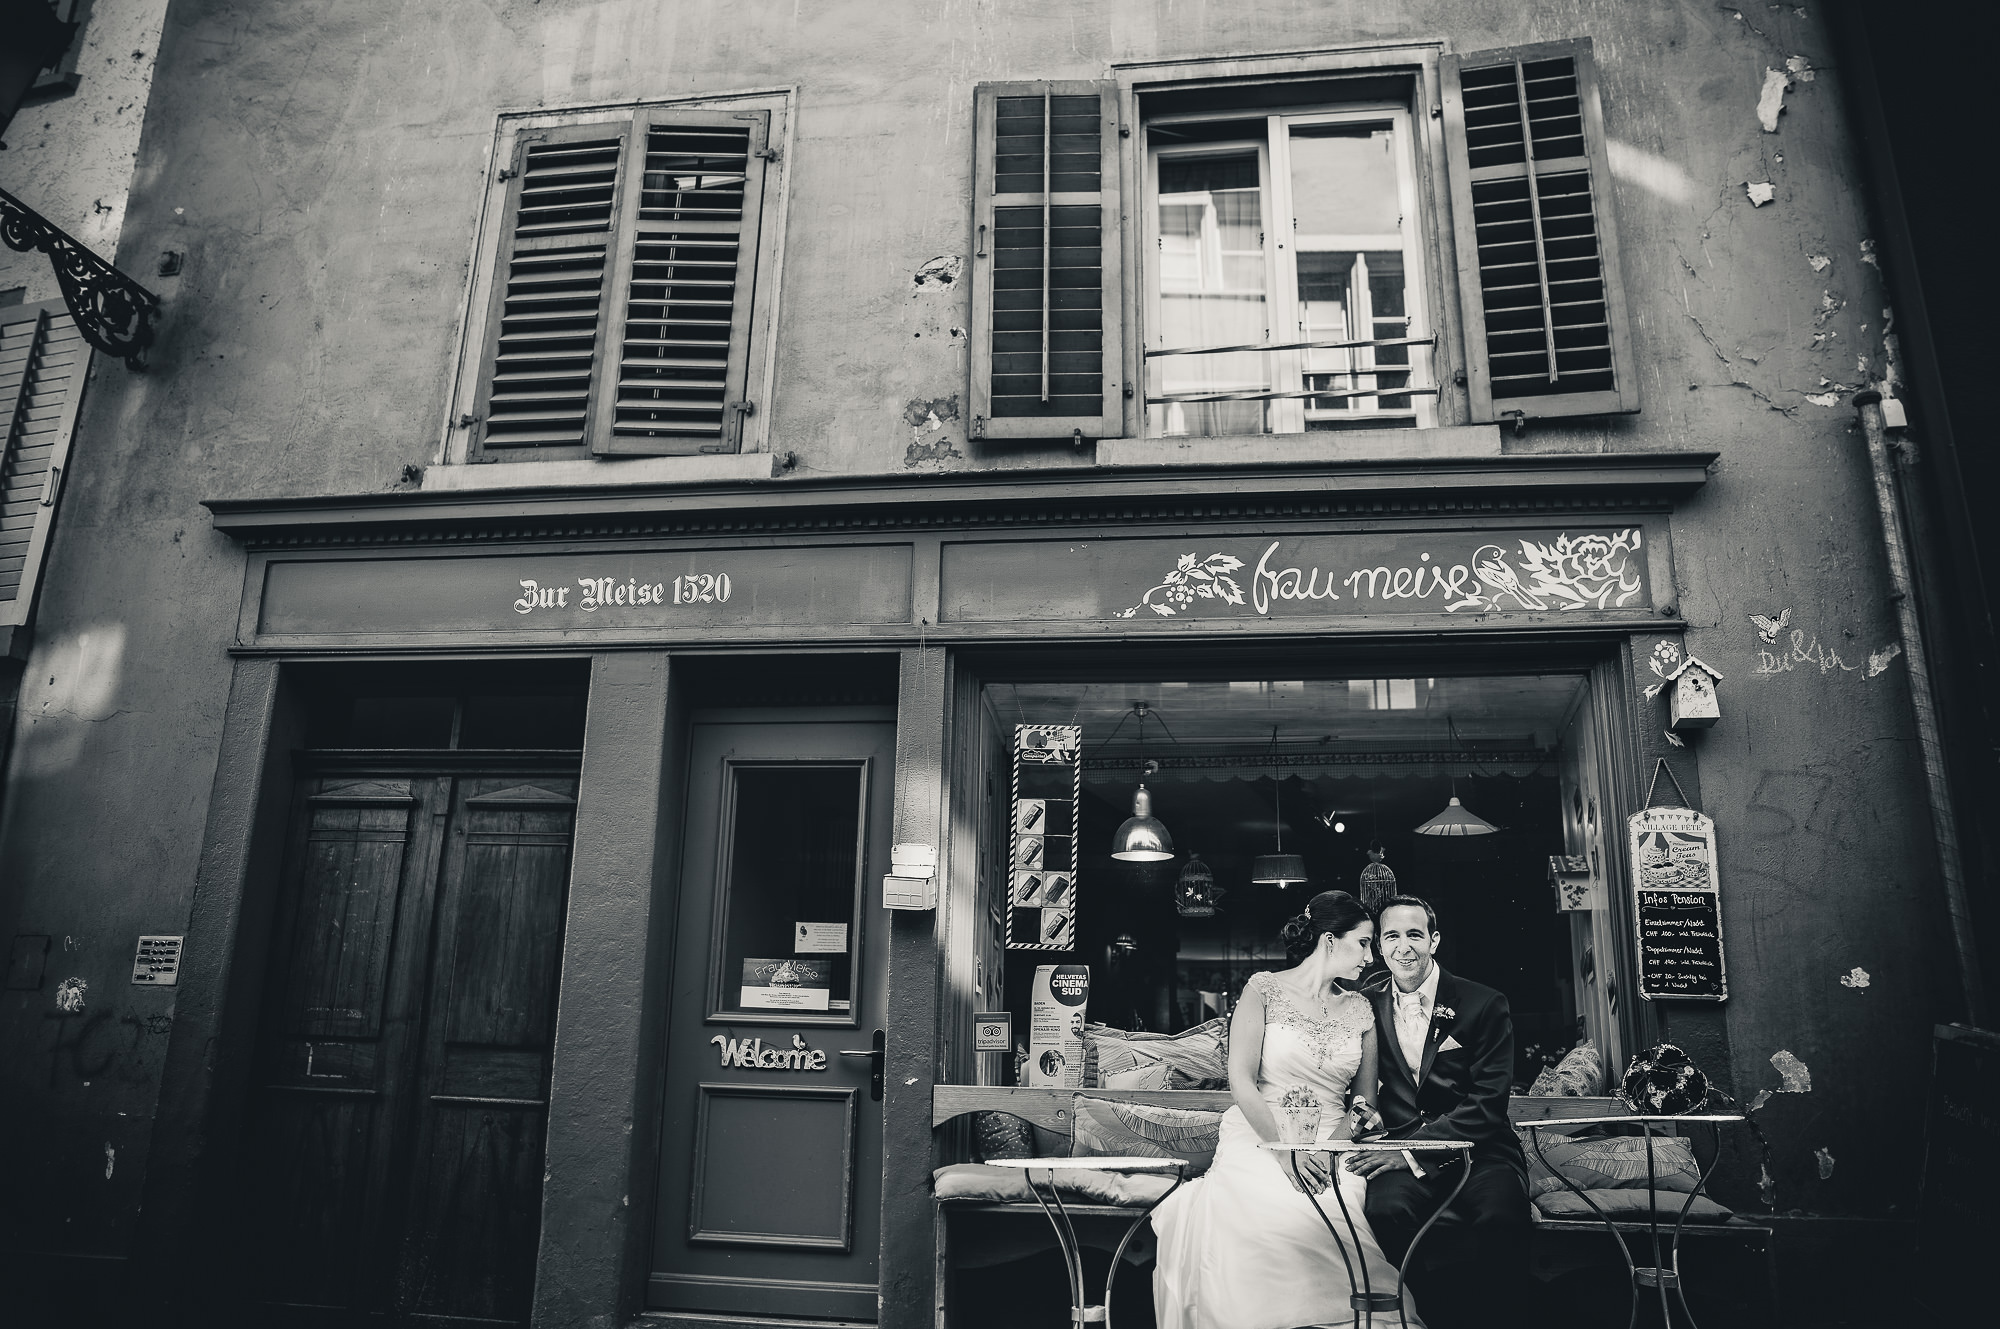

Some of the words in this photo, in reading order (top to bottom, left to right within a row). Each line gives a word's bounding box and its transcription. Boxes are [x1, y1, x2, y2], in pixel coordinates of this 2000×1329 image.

[1253, 541, 1340, 615] frau
[1343, 551, 1470, 601] meise
[513, 578, 571, 614] Zur
[577, 576, 665, 613] Meise
[672, 572, 732, 605] 1520
[1671, 845, 1701, 853] Cream
[1676, 852, 1696, 860] Teas
[1642, 892, 1668, 907] Infos
[1671, 893, 1706, 906] Pension
[1052, 979, 1089, 988] CINEMA
[1061, 987, 1083, 996] SUD
[710, 1034, 827, 1071] Welcome
